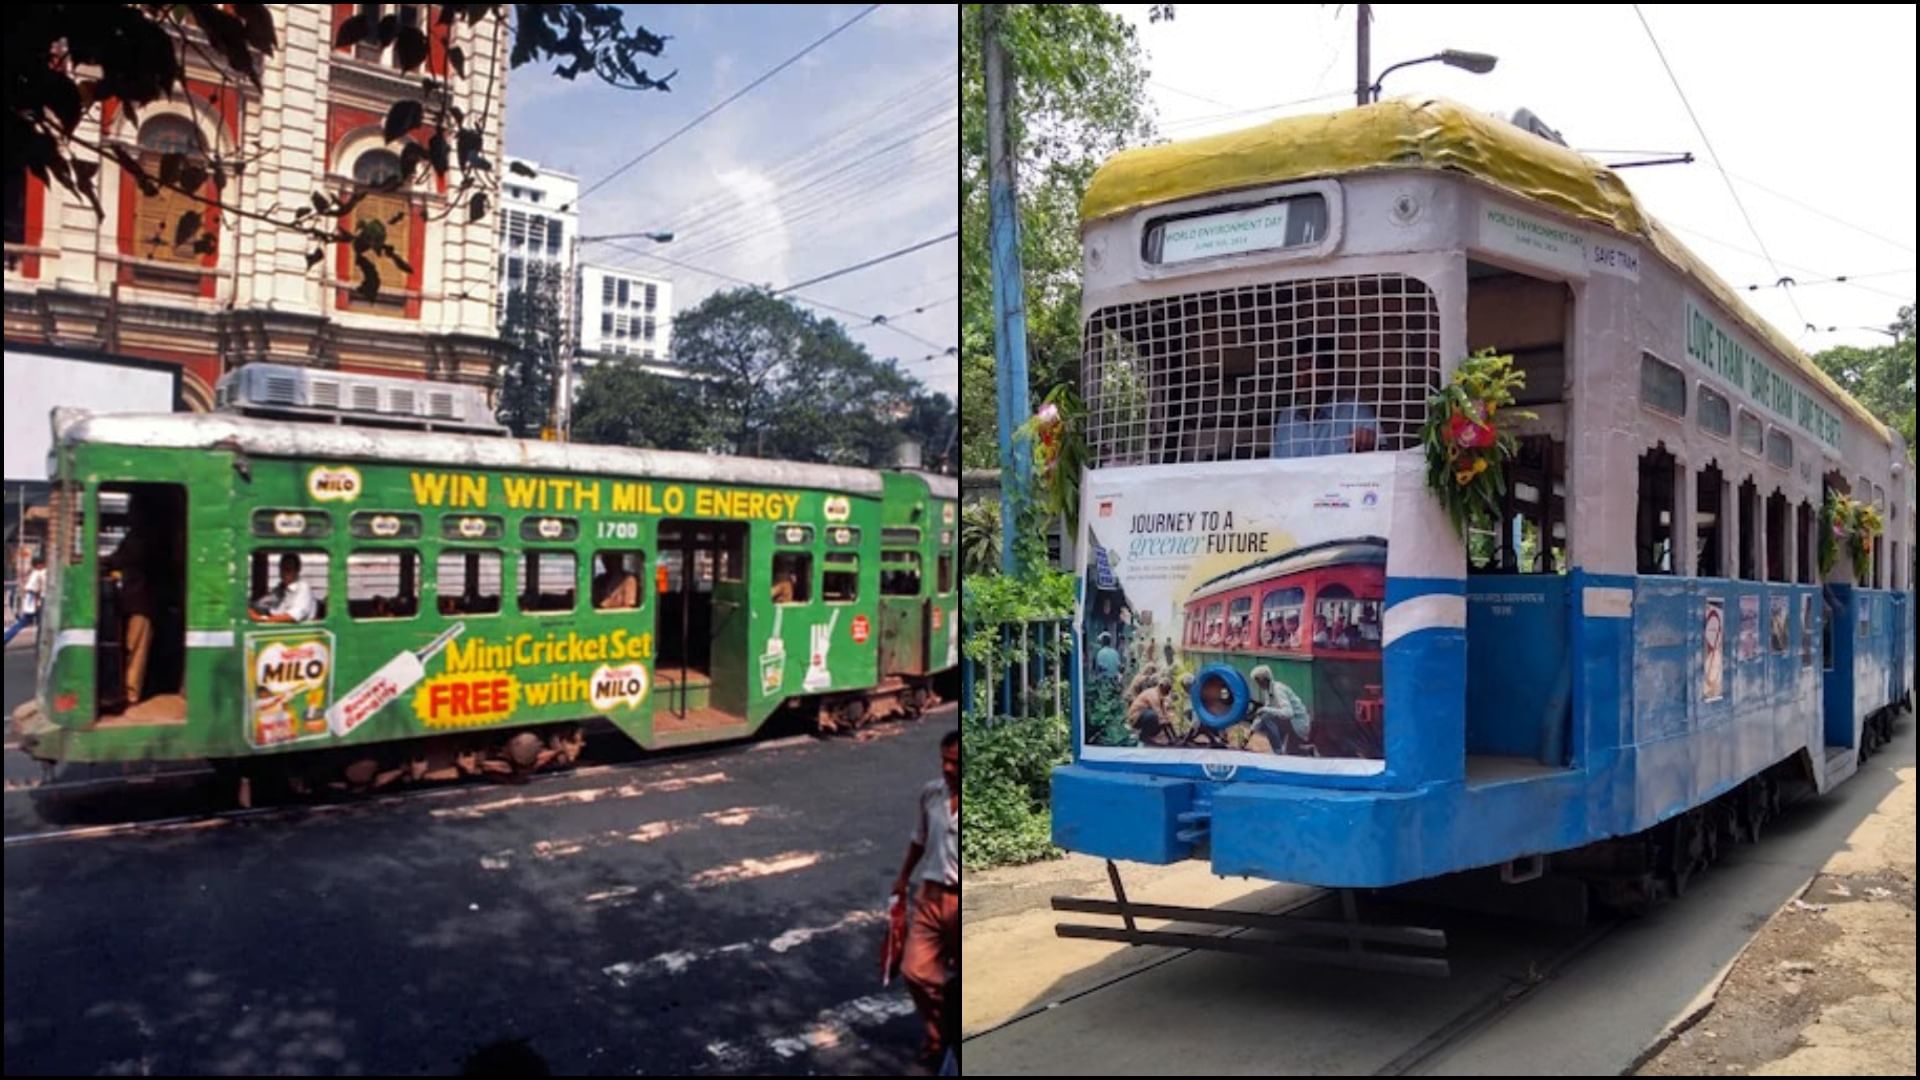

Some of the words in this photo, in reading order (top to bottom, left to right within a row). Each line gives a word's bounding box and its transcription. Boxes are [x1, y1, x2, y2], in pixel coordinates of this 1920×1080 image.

[1166, 228, 1197, 243] WORLD
[1198, 218, 1262, 238] ENVIRONMENT
[1265, 215, 1283, 229] DAY
[1487, 210, 1516, 227] WORLD
[1516, 218, 1568, 243] ENVIRONMENT
[1594, 246, 1616, 267] SAVE
[1618, 250, 1638, 273] TRAM
[1687, 303, 1714, 370] LOVE
[1716, 327, 1745, 391] TRAM
[316, 479, 354, 492] MILO
[411, 472, 488, 507] WIN
[503, 476, 600, 511] WITH
[611, 482, 685, 514] MILO
[695, 487, 800, 520] ENERGY
[597, 521, 638, 539] 1700
[1130, 511, 1197, 535] JOURNEY
[1201, 510, 1219, 532] TO
[1223, 510, 1233, 531] A
[1127, 535, 1205, 562] greener
[1207, 532, 1269, 555] FUTURE
[446, 636, 513, 673] Mini
[514, 632, 608, 666] Cricket
[610, 629, 652, 660] Set
[262, 659, 323, 684] MILO
[429, 678, 510, 719] FREE
[523, 671, 589, 706] with
[595, 678, 642, 700] MILO
